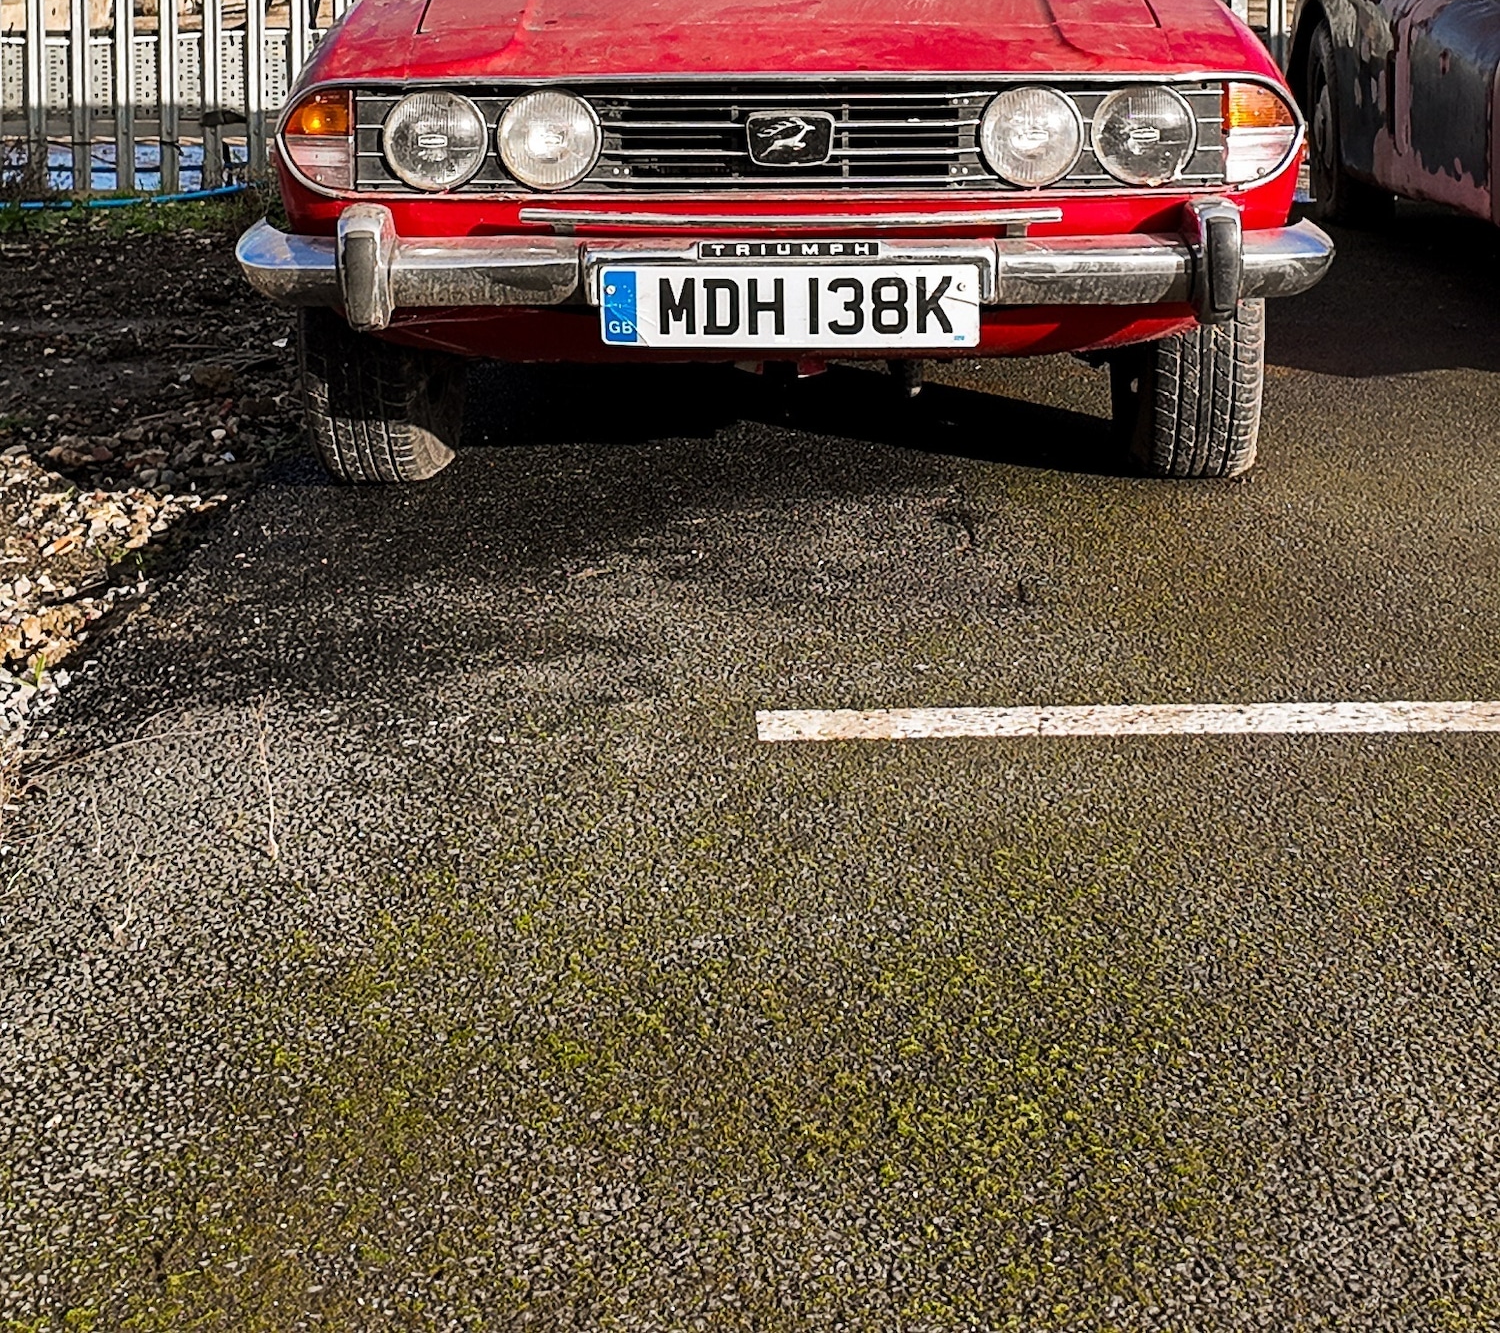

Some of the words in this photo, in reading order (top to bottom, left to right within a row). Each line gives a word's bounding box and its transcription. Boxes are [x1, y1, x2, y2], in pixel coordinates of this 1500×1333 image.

[711, 243, 870, 257] TRIUMPH
[658, 278, 785, 336] MDH
[809, 276, 953, 335] 138K
[608, 321, 633, 336] GB
